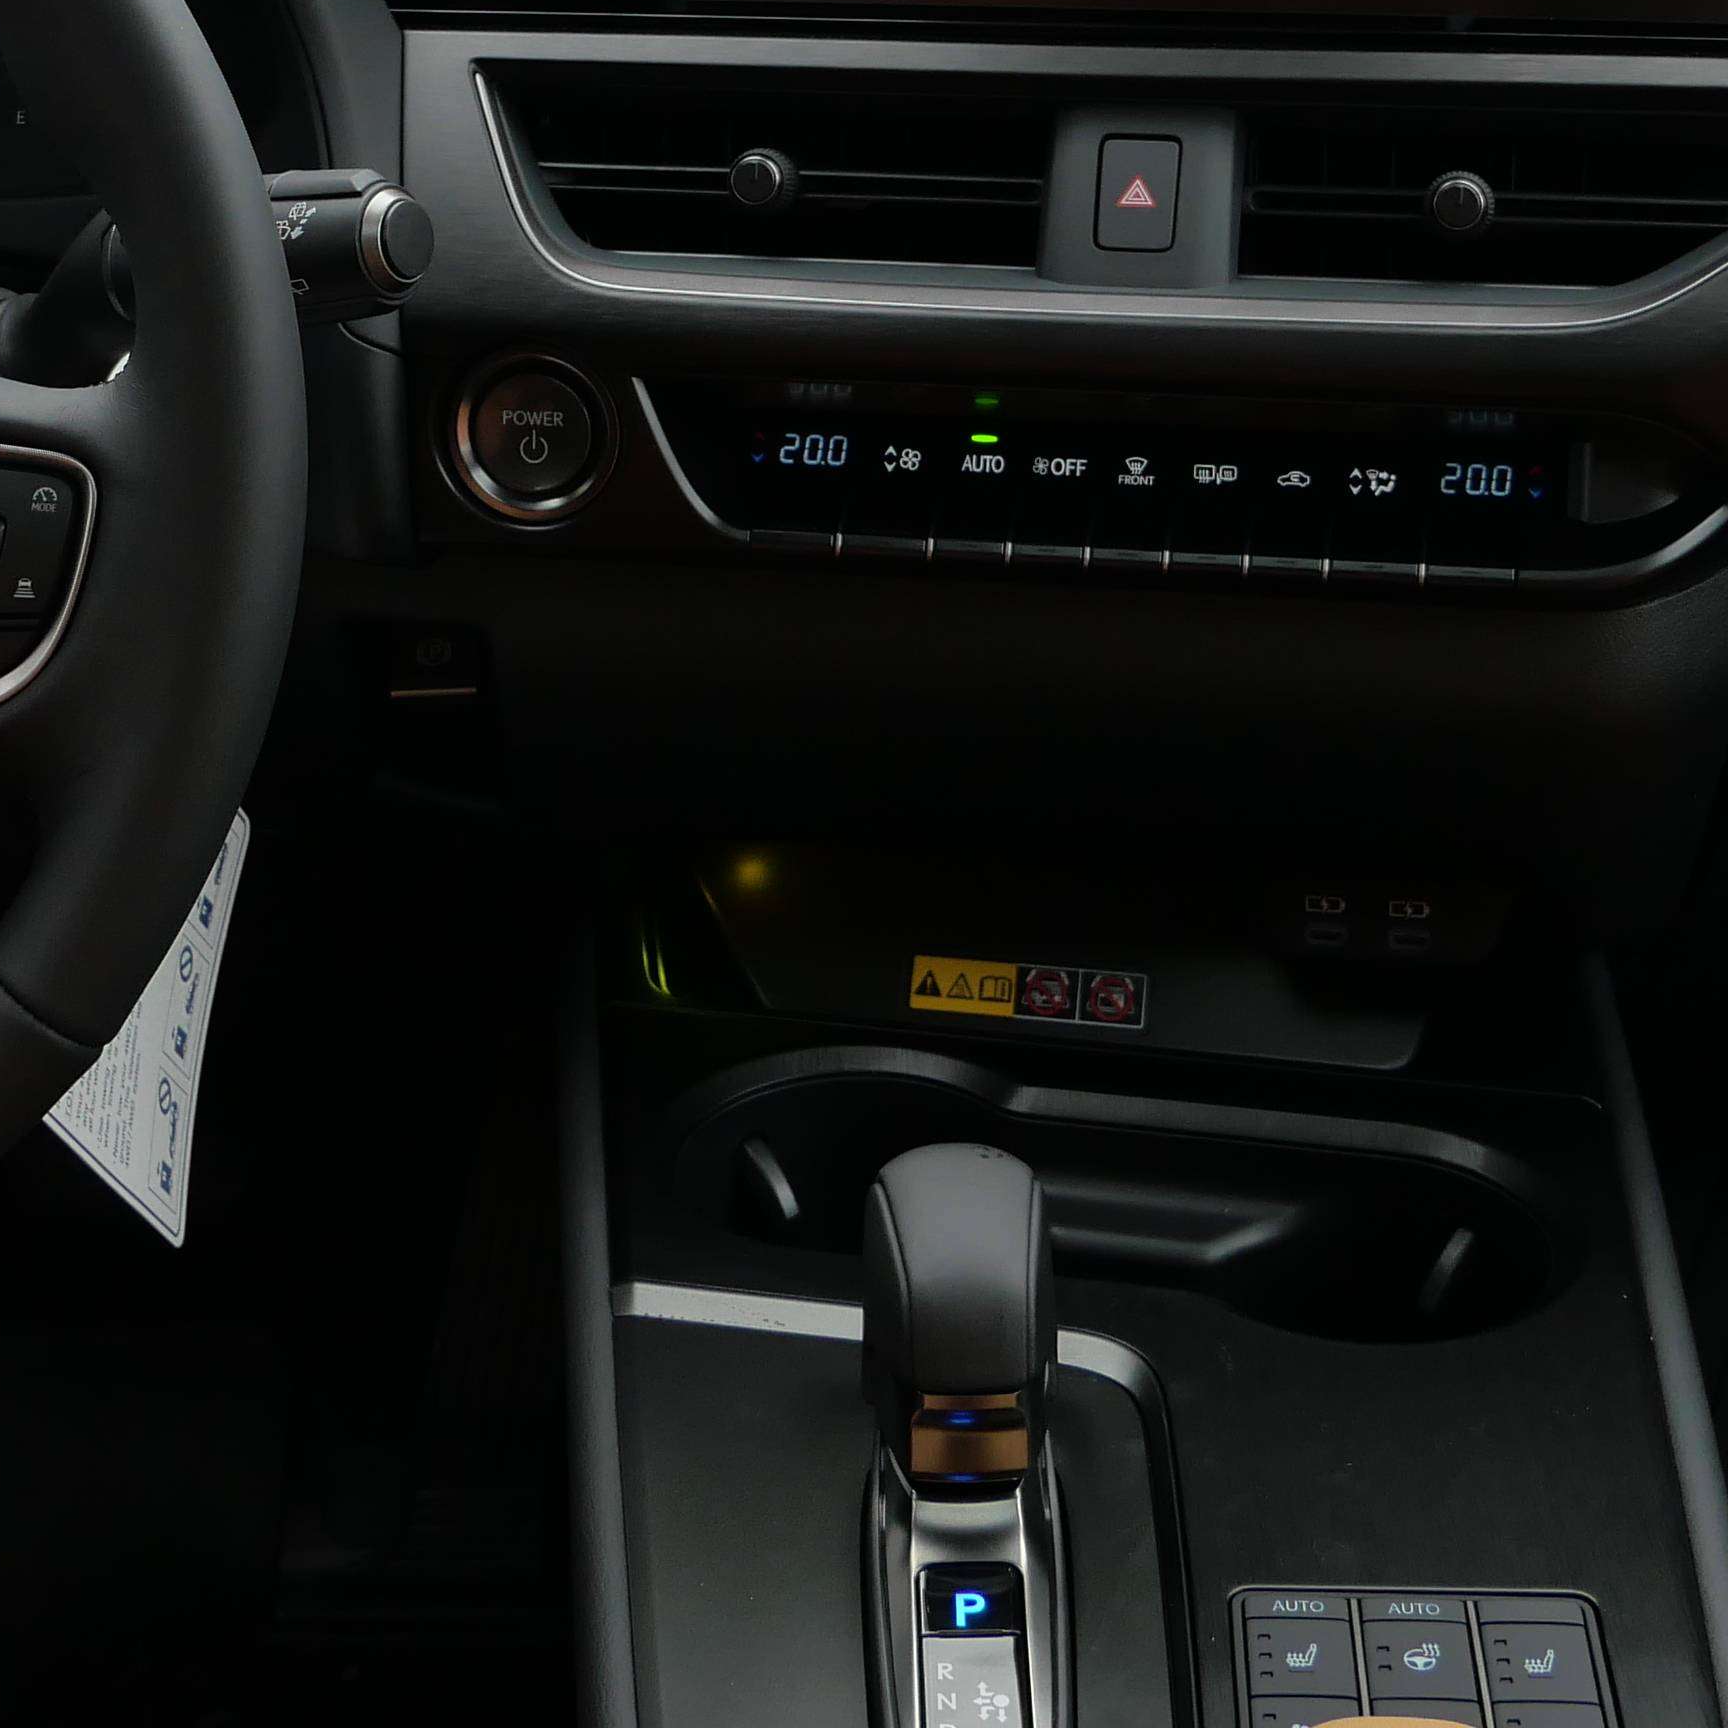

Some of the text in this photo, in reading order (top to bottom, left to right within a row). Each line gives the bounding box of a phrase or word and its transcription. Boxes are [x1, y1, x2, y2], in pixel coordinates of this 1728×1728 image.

[502, 410, 565, 427] POWER
[779, 432, 849, 467] 20.0
[960, 454, 1006, 475] AUTO
[1050, 457, 1089, 478] OFF
[1117, 474, 1156, 487] FRONT
[1441, 462, 1514, 498] 20.0
[31, 503, 57, 513] MODE
[955, 1592, 986, 1628] P
[1272, 1599, 1325, 1613] AUTO
[1388, 1602, 1440, 1615] AUTO
[938, 1663, 954, 1680] R
[938, 1693, 957, 1710] N
